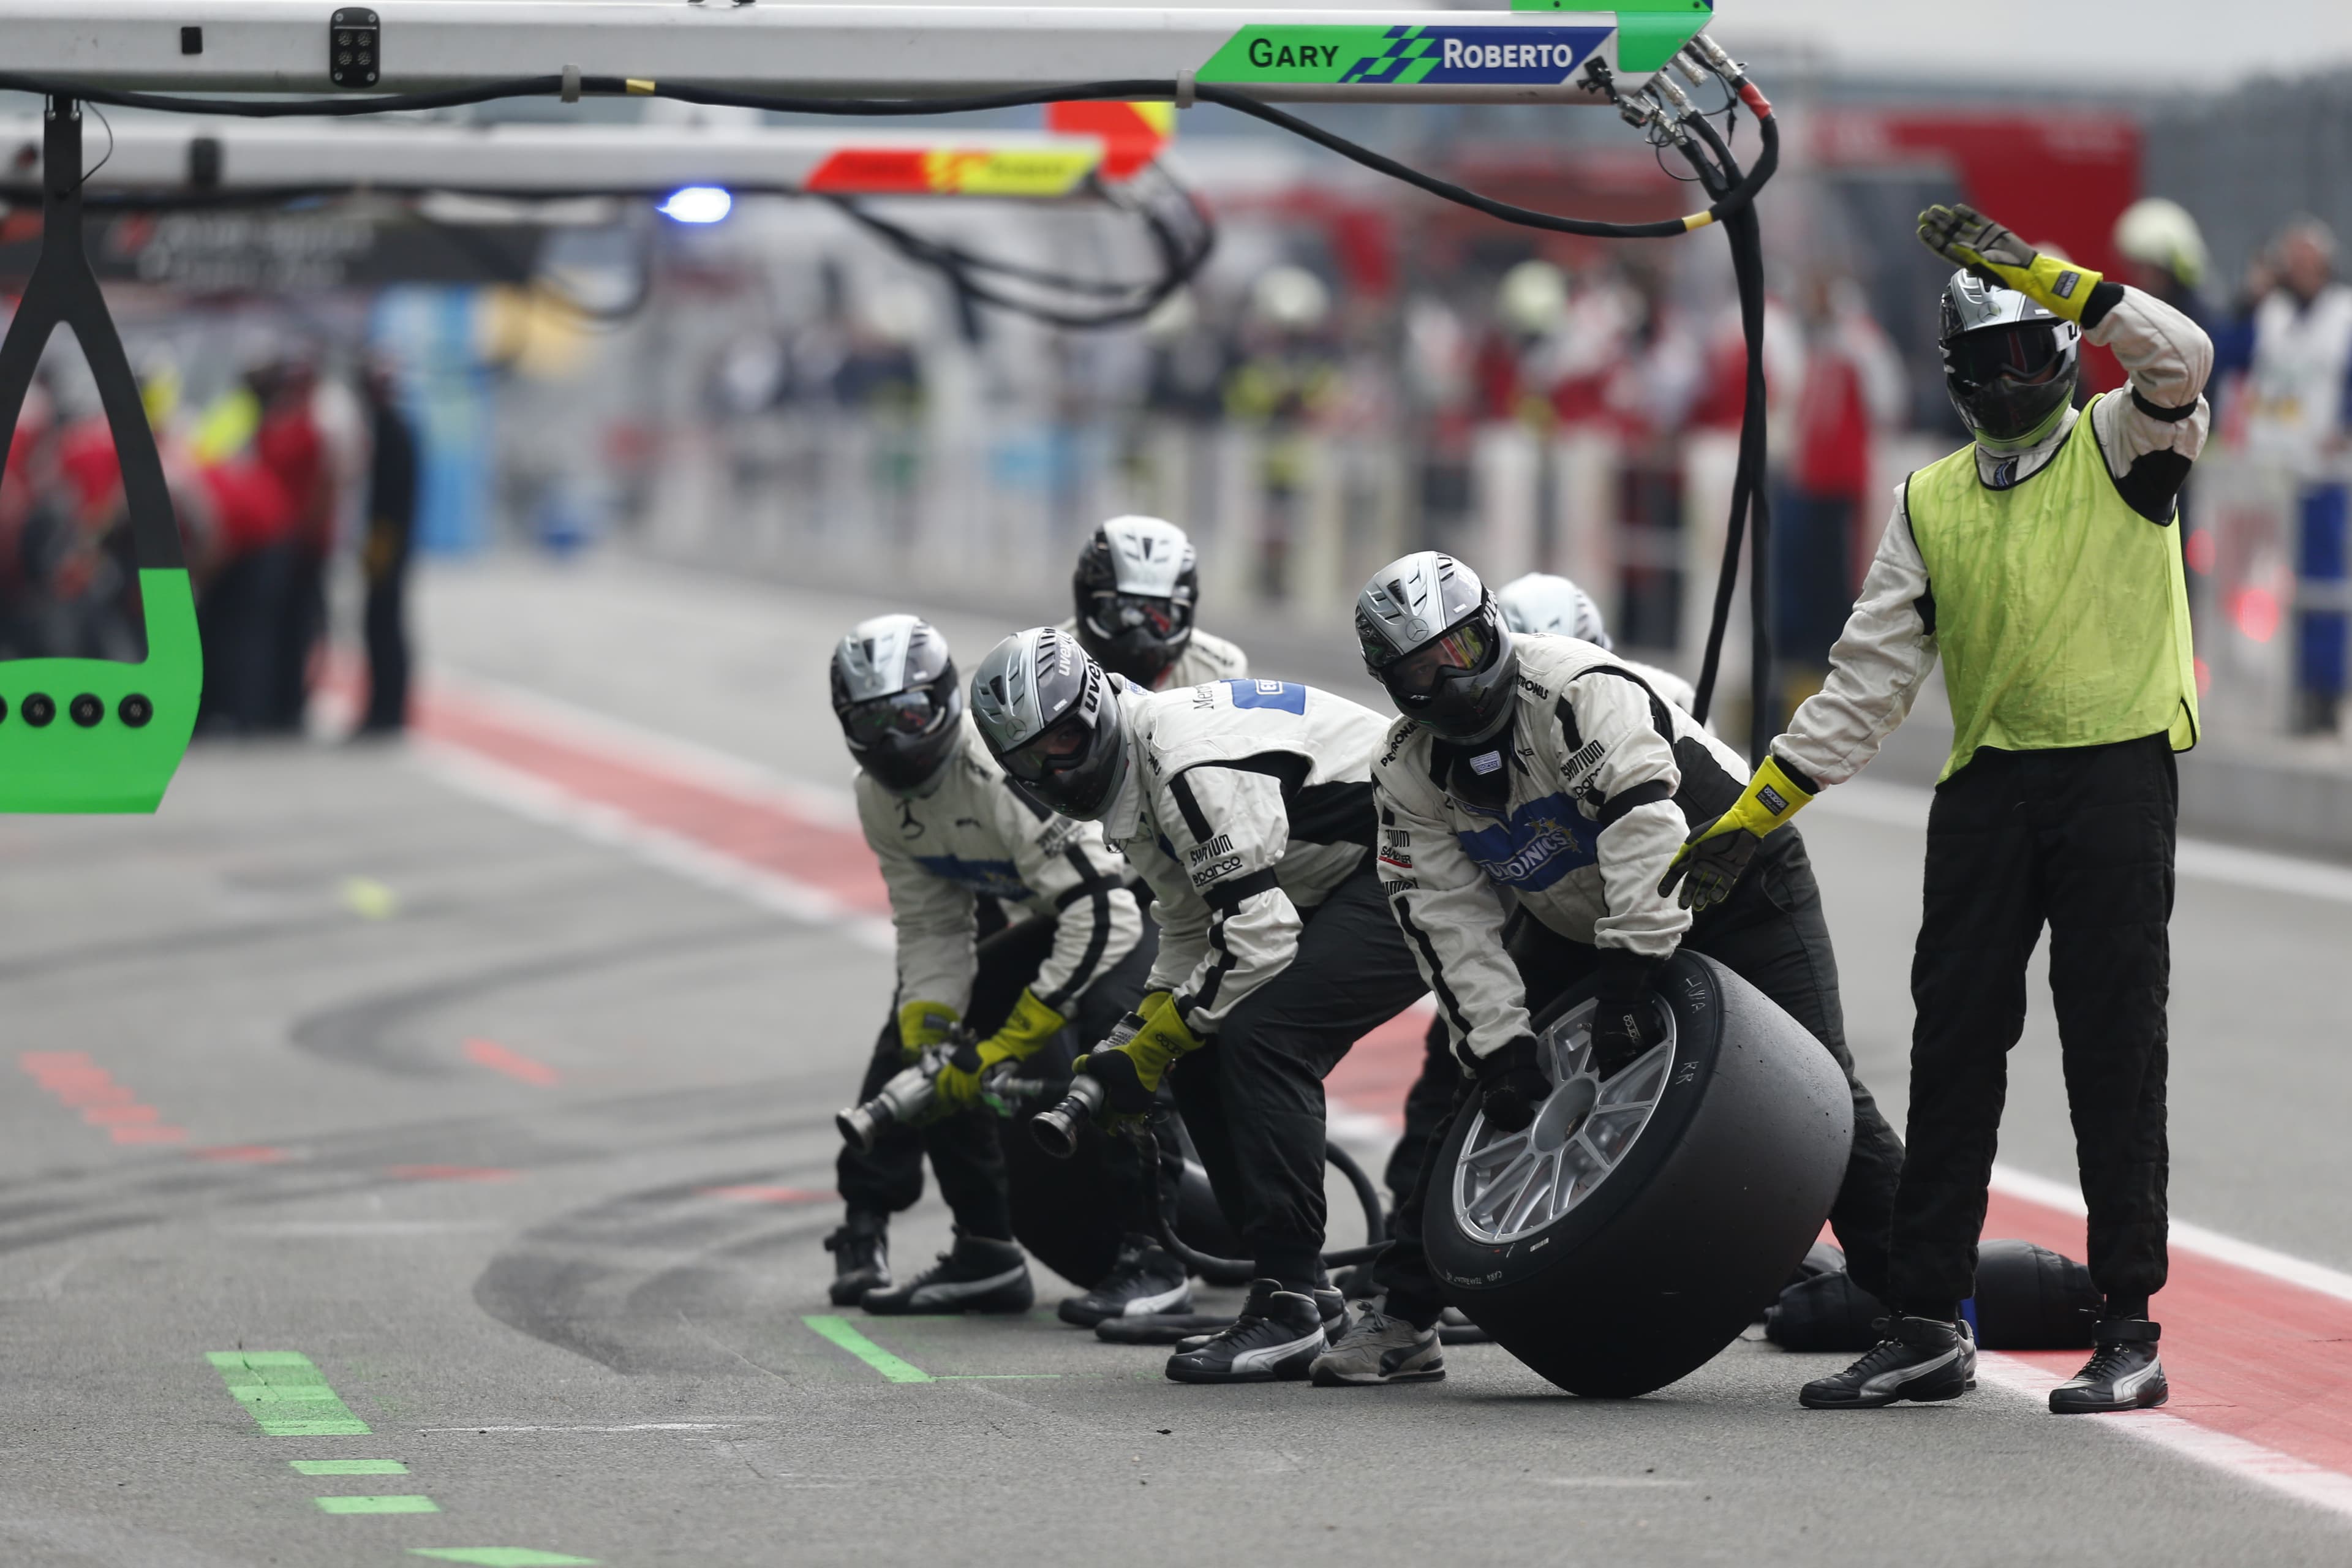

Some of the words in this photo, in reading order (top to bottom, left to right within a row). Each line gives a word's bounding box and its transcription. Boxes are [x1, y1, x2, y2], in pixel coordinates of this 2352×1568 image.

[1249, 38, 1340, 68] GARY
[1444, 38, 1573, 69] ROBERTO
[1518, 674, 1548, 699] TRONAS
[1380, 722, 1419, 767] PETRONA
[1560, 740, 1605, 782] SYNTIUM
[1192, 856, 1243, 888] sparco
